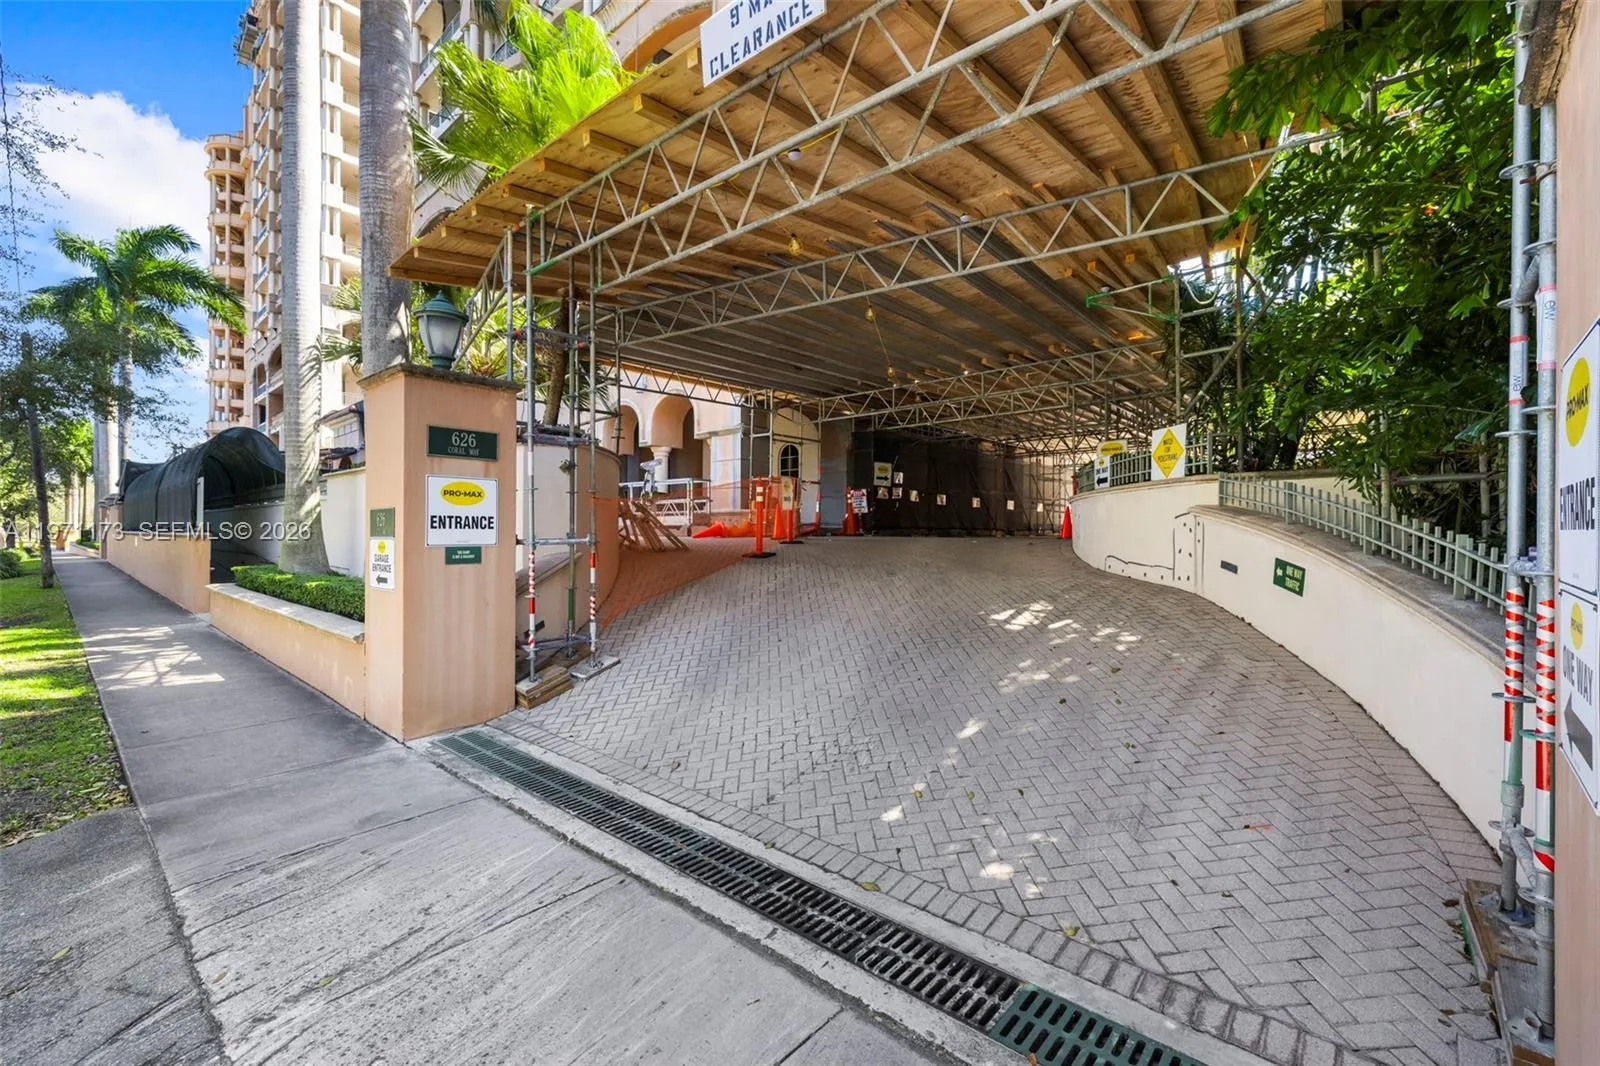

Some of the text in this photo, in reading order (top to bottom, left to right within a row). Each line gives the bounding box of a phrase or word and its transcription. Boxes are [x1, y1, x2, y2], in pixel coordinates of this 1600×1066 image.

[709, 0, 813, 78] CLEARANCE
[452, 432, 477, 448] 626
[447, 446, 466, 456] CORAL
[443, 489, 483, 498] PRO-MAX
[1560, 476, 1596, 531] ENTRANCE
[429, 514, 495, 530] ENTRANCE
[372, 563, 392, 574] ENTRANCE
[1562, 645, 1593, 706] ONE WAY
